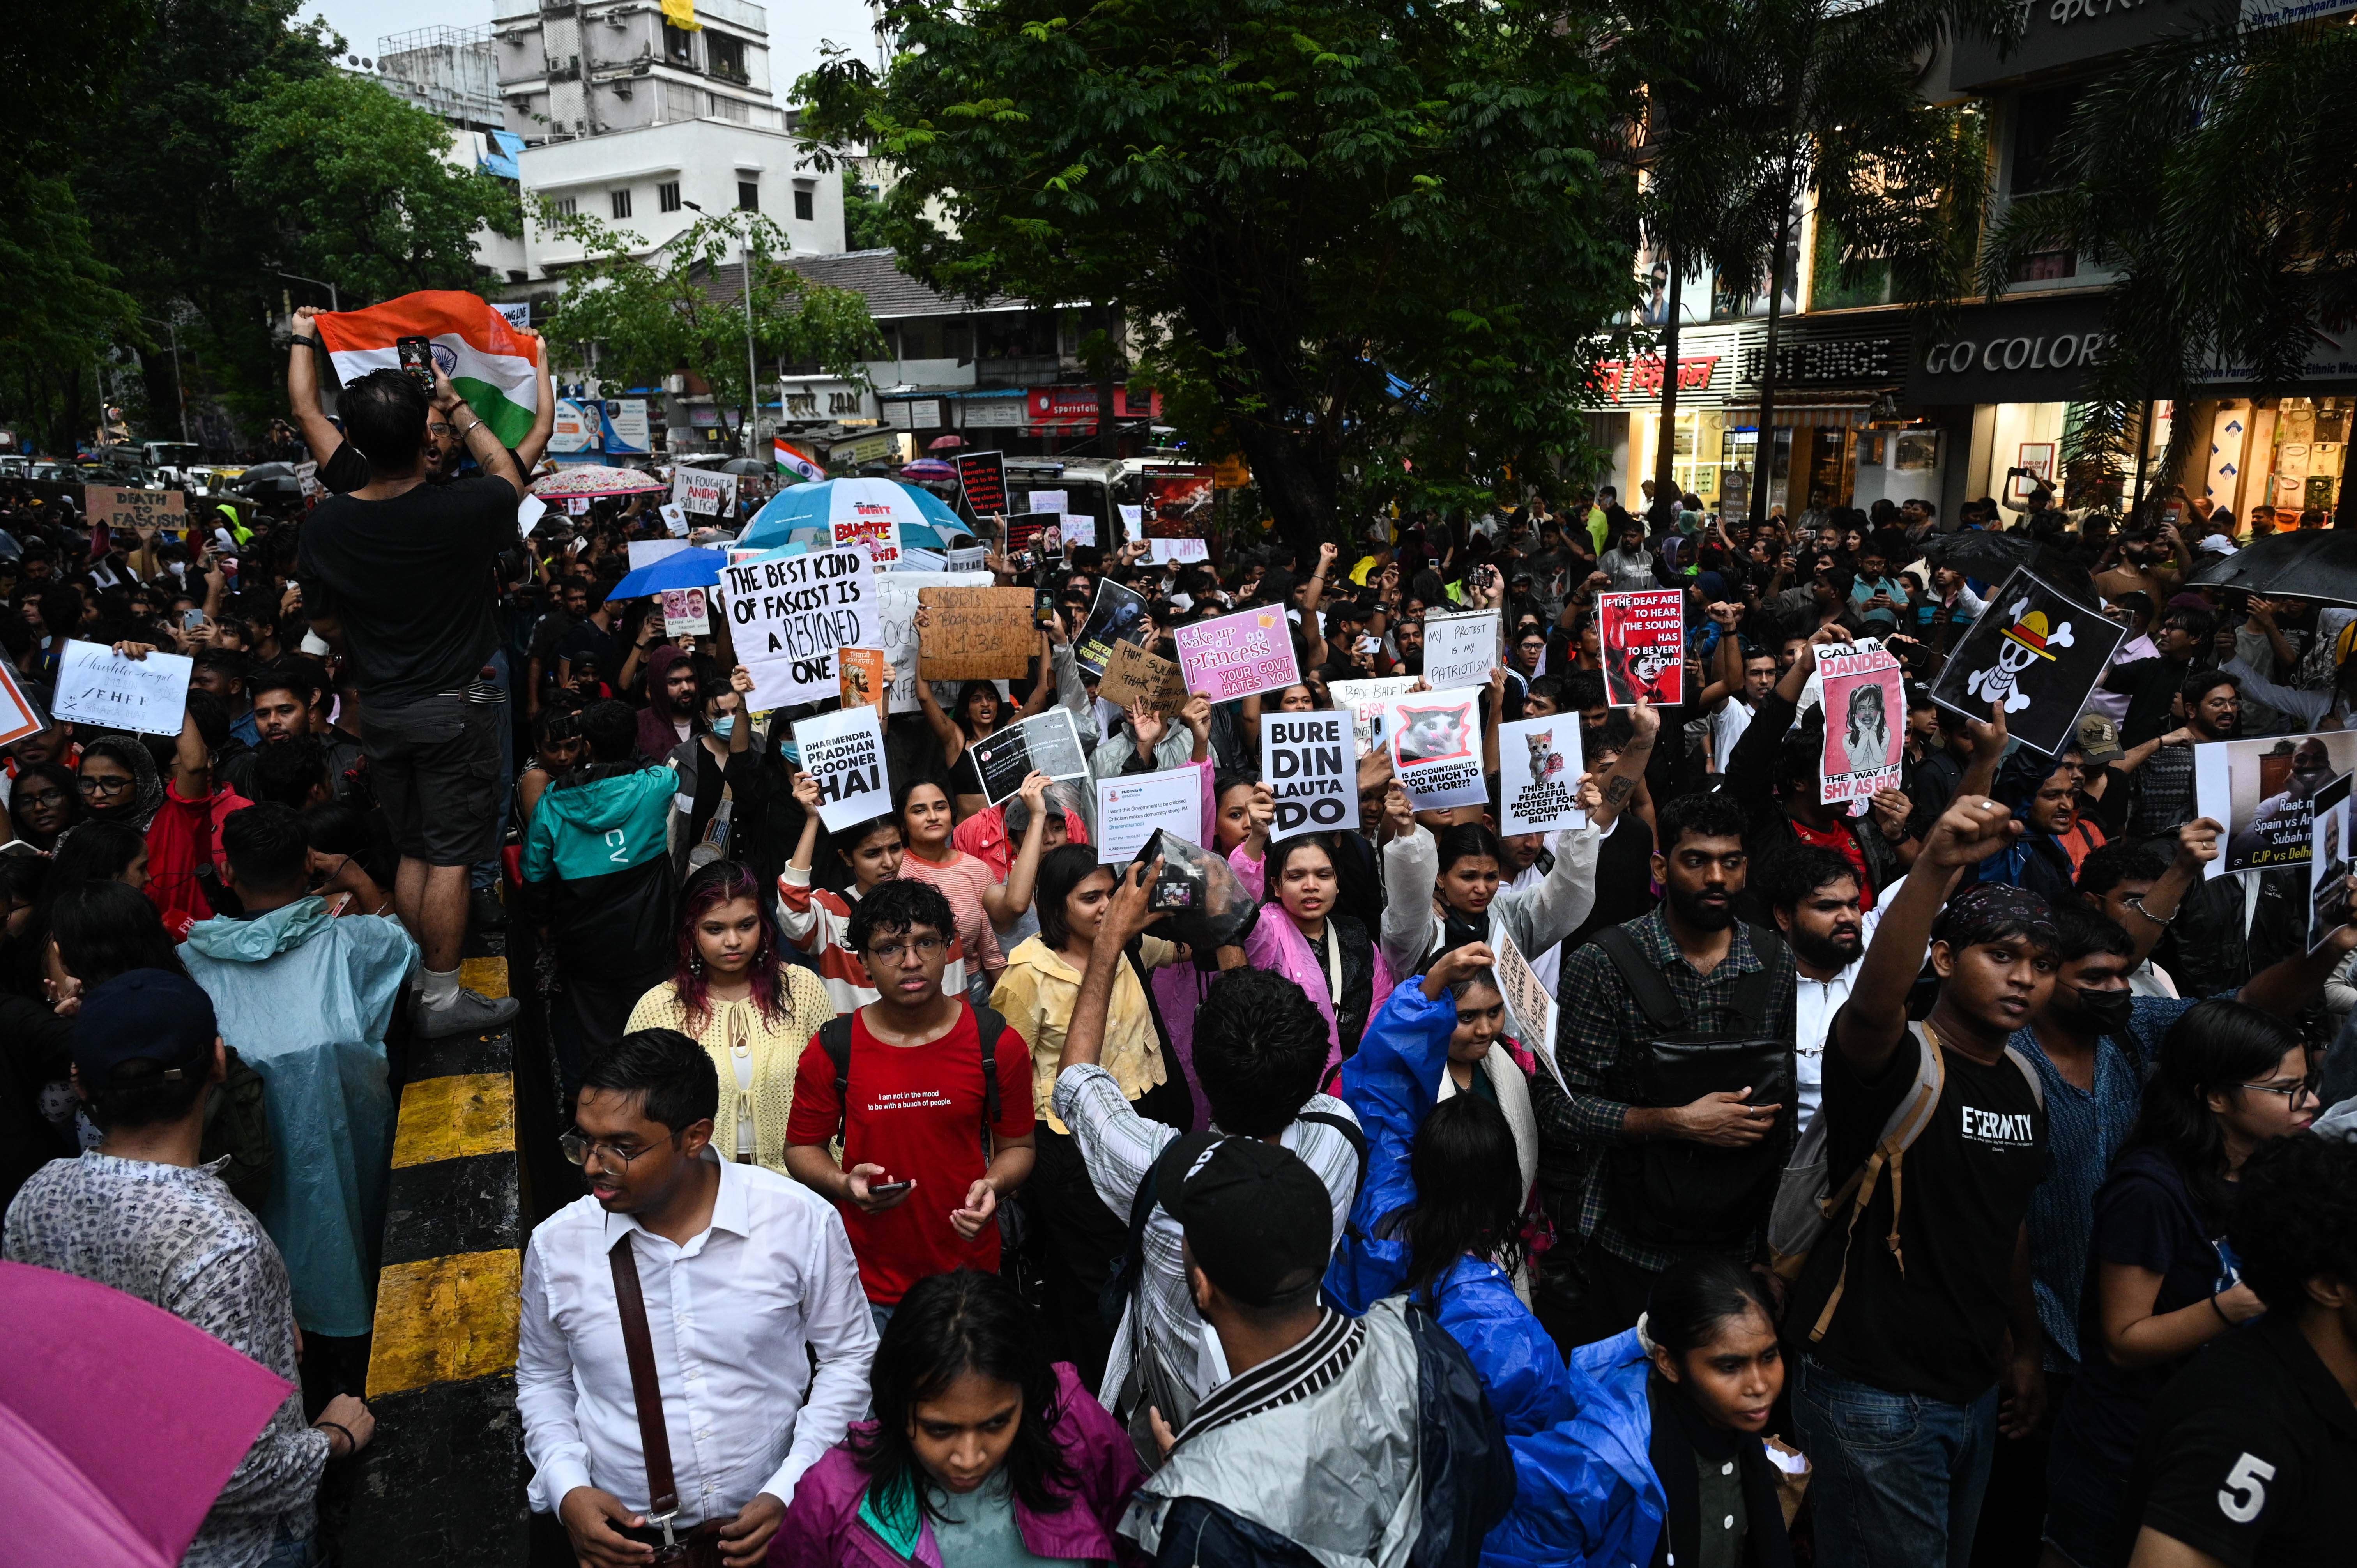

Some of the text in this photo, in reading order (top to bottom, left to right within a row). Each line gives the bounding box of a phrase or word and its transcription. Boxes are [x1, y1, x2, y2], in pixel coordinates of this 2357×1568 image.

[516, 306, 526, 319] LIVE
[1802, 339, 1890, 379] BINGE
[1926, 341, 1976, 374] GO
[2305, 362, 2335, 375] Ethnic
[1054, 405, 1098, 414] sportsfoli
[680, 474, 692, 484] TN
[116, 493, 167, 506] DEATH
[858, 506, 891, 514] WAIT
[112, 513, 185, 527] FASCISM
[726, 553, 860, 595] THE BEST KIND
[734, 580, 860, 624] OF FASCIST IS
[1604, 595, 1680, 607] IF THE DEAF ARE
[1634, 608, 1680, 618] TO HEAR,
[1624, 620, 1680, 631] THE SOUND
[768, 609, 860, 662] A RESIGNED
[1182, 626, 1235, 648] wake up
[1429, 624, 1486, 645] MY PROTEST
[1658, 633, 1678, 642] HAS
[1123, 645, 1142, 662] HUM
[1464, 643, 1475, 654] MY
[1627, 645, 1680, 656] TO BE VERY
[1818, 642, 1883, 659] CALL ME
[792, 656, 835, 684] ONE.
[1187, 640, 1270, 684] princess
[1220, 656, 1290, 683] YOUR GOVT
[1654, 658, 1680, 666] LOUD
[1820, 650, 1898, 677] DANDERE
[1222, 669, 1293, 696] HATES YOU
[1341, 685, 1369, 703] BADE
[805, 730, 872, 751] DHARMENDRA
[1271, 721, 1340, 744] BURE
[992, 733, 1027, 752] Dharmendra Pradhan
[807, 739, 875, 764] PRADHAN
[811, 752, 877, 776] GOONER
[985, 761, 998, 771] Thanks
[987, 767, 997, 776] Sikim
[996, 762, 1007, 771] friend
[1010, 753, 1025, 762] Kolkata
[1272, 746, 1342, 778] DIN
[1411, 760, 1477, 778] ACCOUNTABILITY
[1403, 768, 1478, 788] TOO MUCH TO
[1824, 774, 1849, 784] THE
[1854, 769, 1880, 779] WAY
[1890, 763, 1900, 773] AM
[814, 764, 881, 807] HAI
[1272, 779, 1344, 799] LAUTA
[1415, 778, 1471, 795] ASK FOR???
[1521, 781, 1565, 794] THIS IS A
[1824, 771, 1900, 800] SHY AS FUCK
[1510, 795, 1576, 811] PROTEST FOR
[1519, 788, 1568, 802] PEACEFUL
[1131, 803, 1158, 811] Government
[1513, 804, 1574, 818] ACCOUNTA-
[2280, 799, 2304, 811] Raat
[1144, 810, 1167, 818] democracy
[1275, 798, 1345, 832] DO
[1528, 813, 1559, 824] BILITY
[1108, 820, 1144, 831] @narendramodi
[2254, 818, 2281, 835] Spain
[2285, 818, 2297, 827] vs
[2272, 829, 2302, 845] Subah
[2252, 845, 2312, 863] CJP vs Delhi
[930, 1098, 951, 1108] people.
[2219, 1453, 2276, 1524] 5
